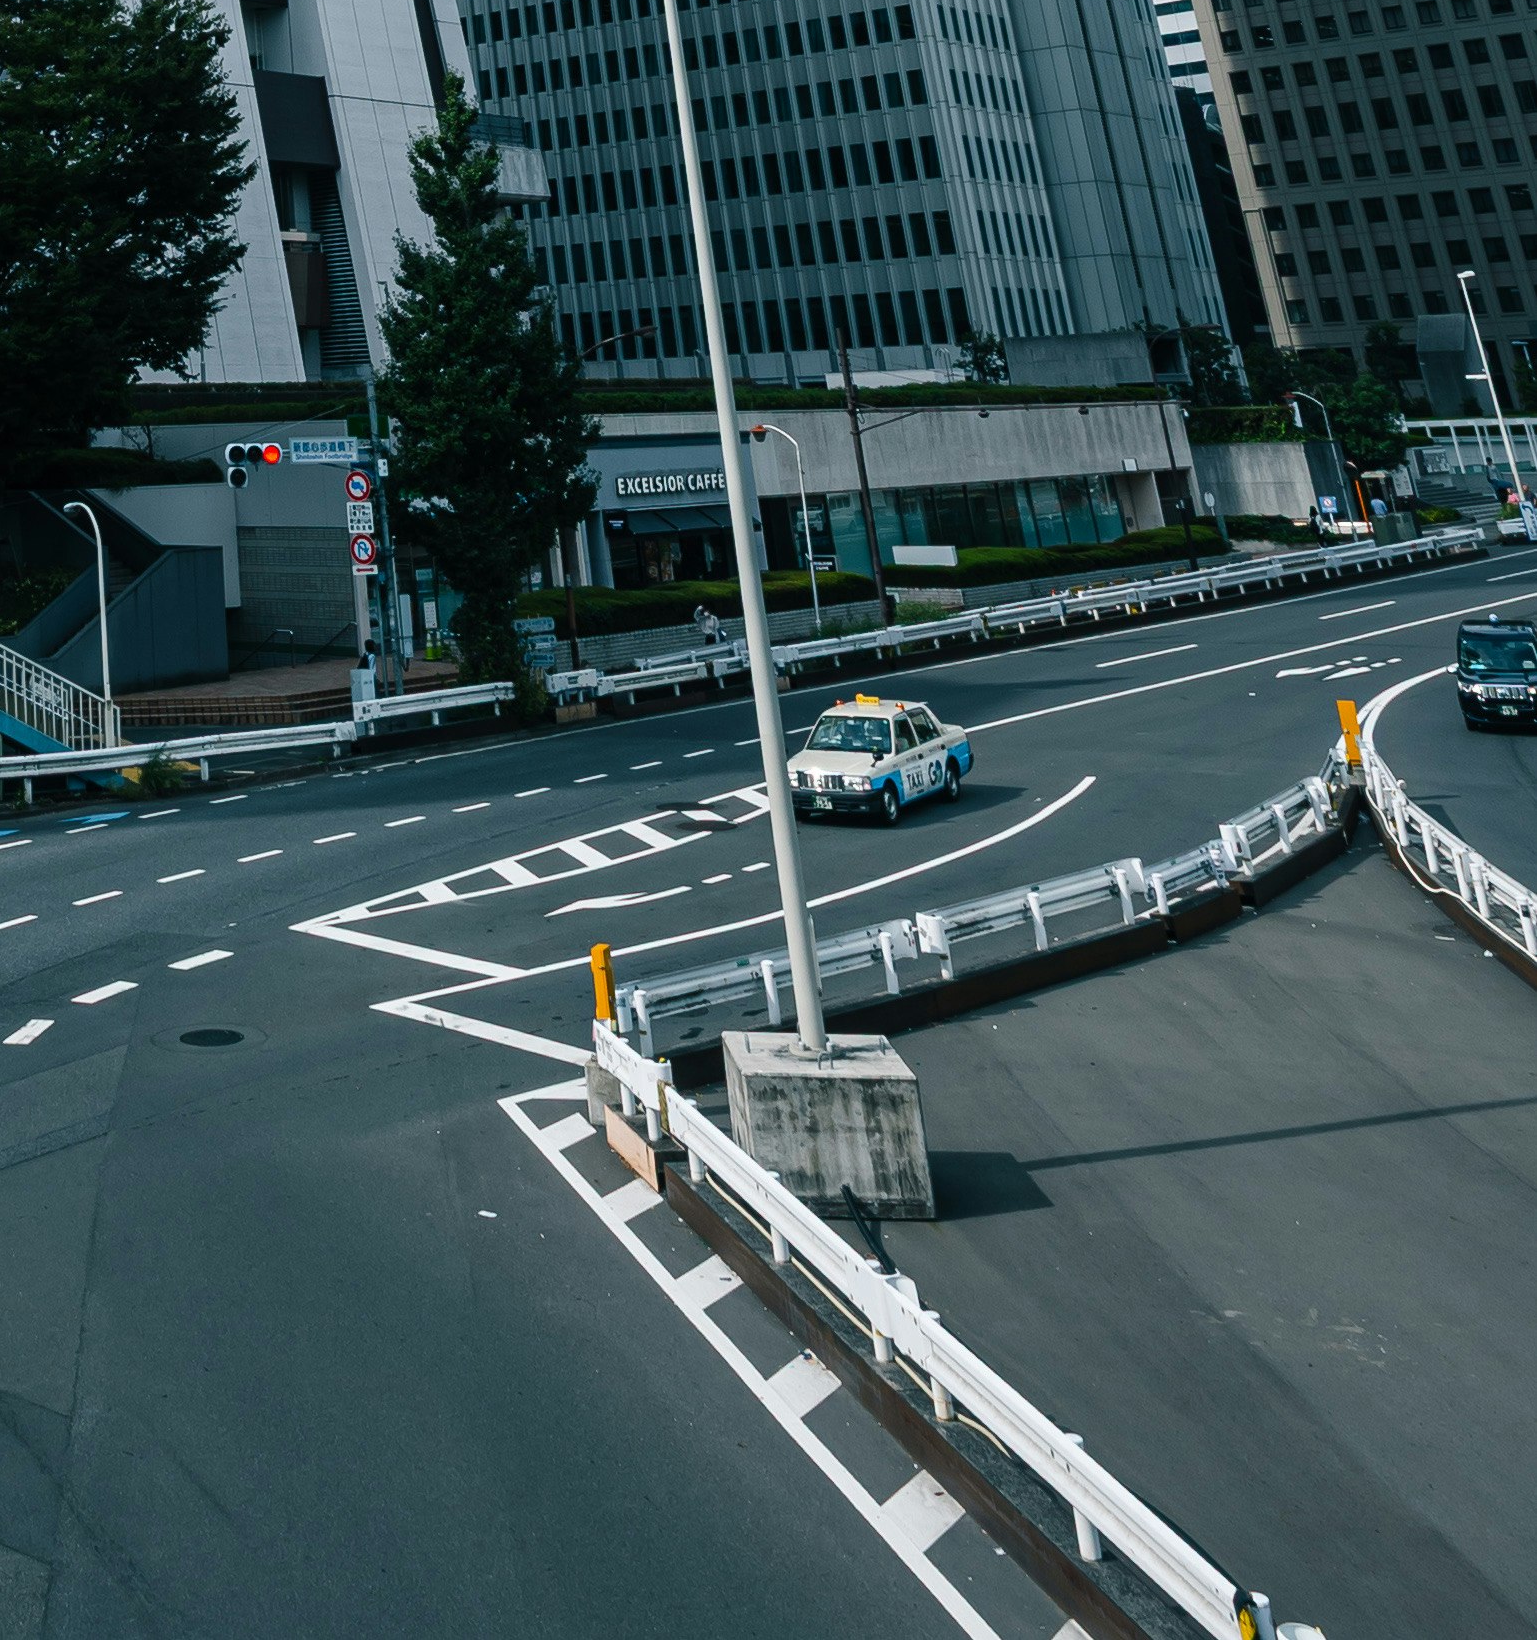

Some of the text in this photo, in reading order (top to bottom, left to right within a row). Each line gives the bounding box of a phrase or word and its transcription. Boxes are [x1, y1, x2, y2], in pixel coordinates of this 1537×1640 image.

[617, 475, 685, 495] EXCELSIOR
[906, 759, 944, 790] TAXI GO
